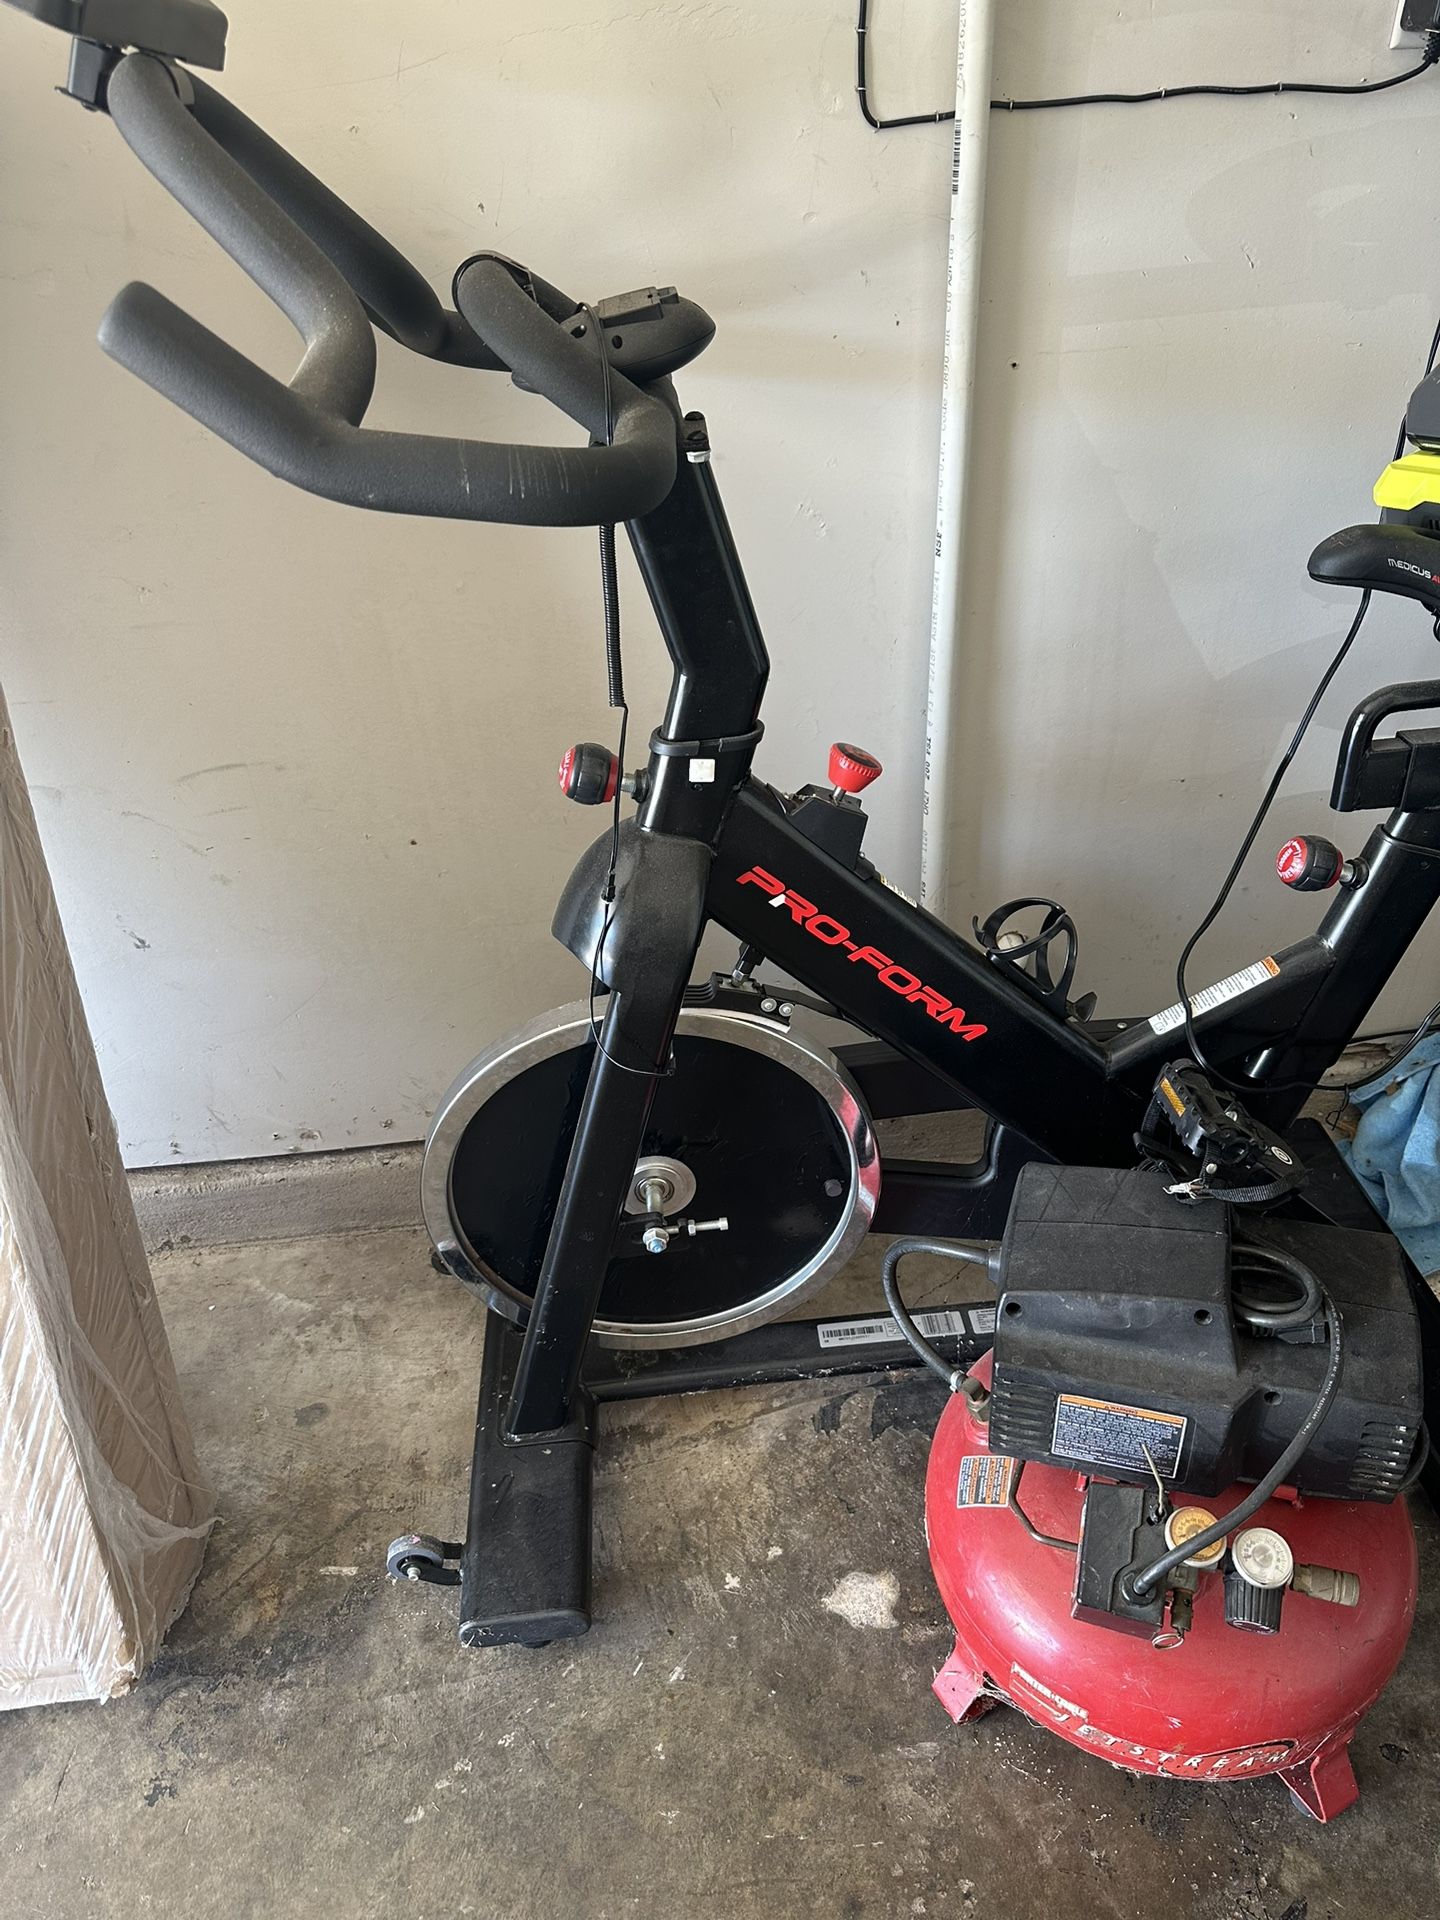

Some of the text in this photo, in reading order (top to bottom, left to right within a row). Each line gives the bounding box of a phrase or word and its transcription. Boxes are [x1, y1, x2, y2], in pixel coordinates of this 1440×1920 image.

[1388, 558, 1431, 579] MEDICUS
[736, 866, 988, 1042] PRO-FORM
[1054, 1712, 1290, 1769] JETSTREAM
